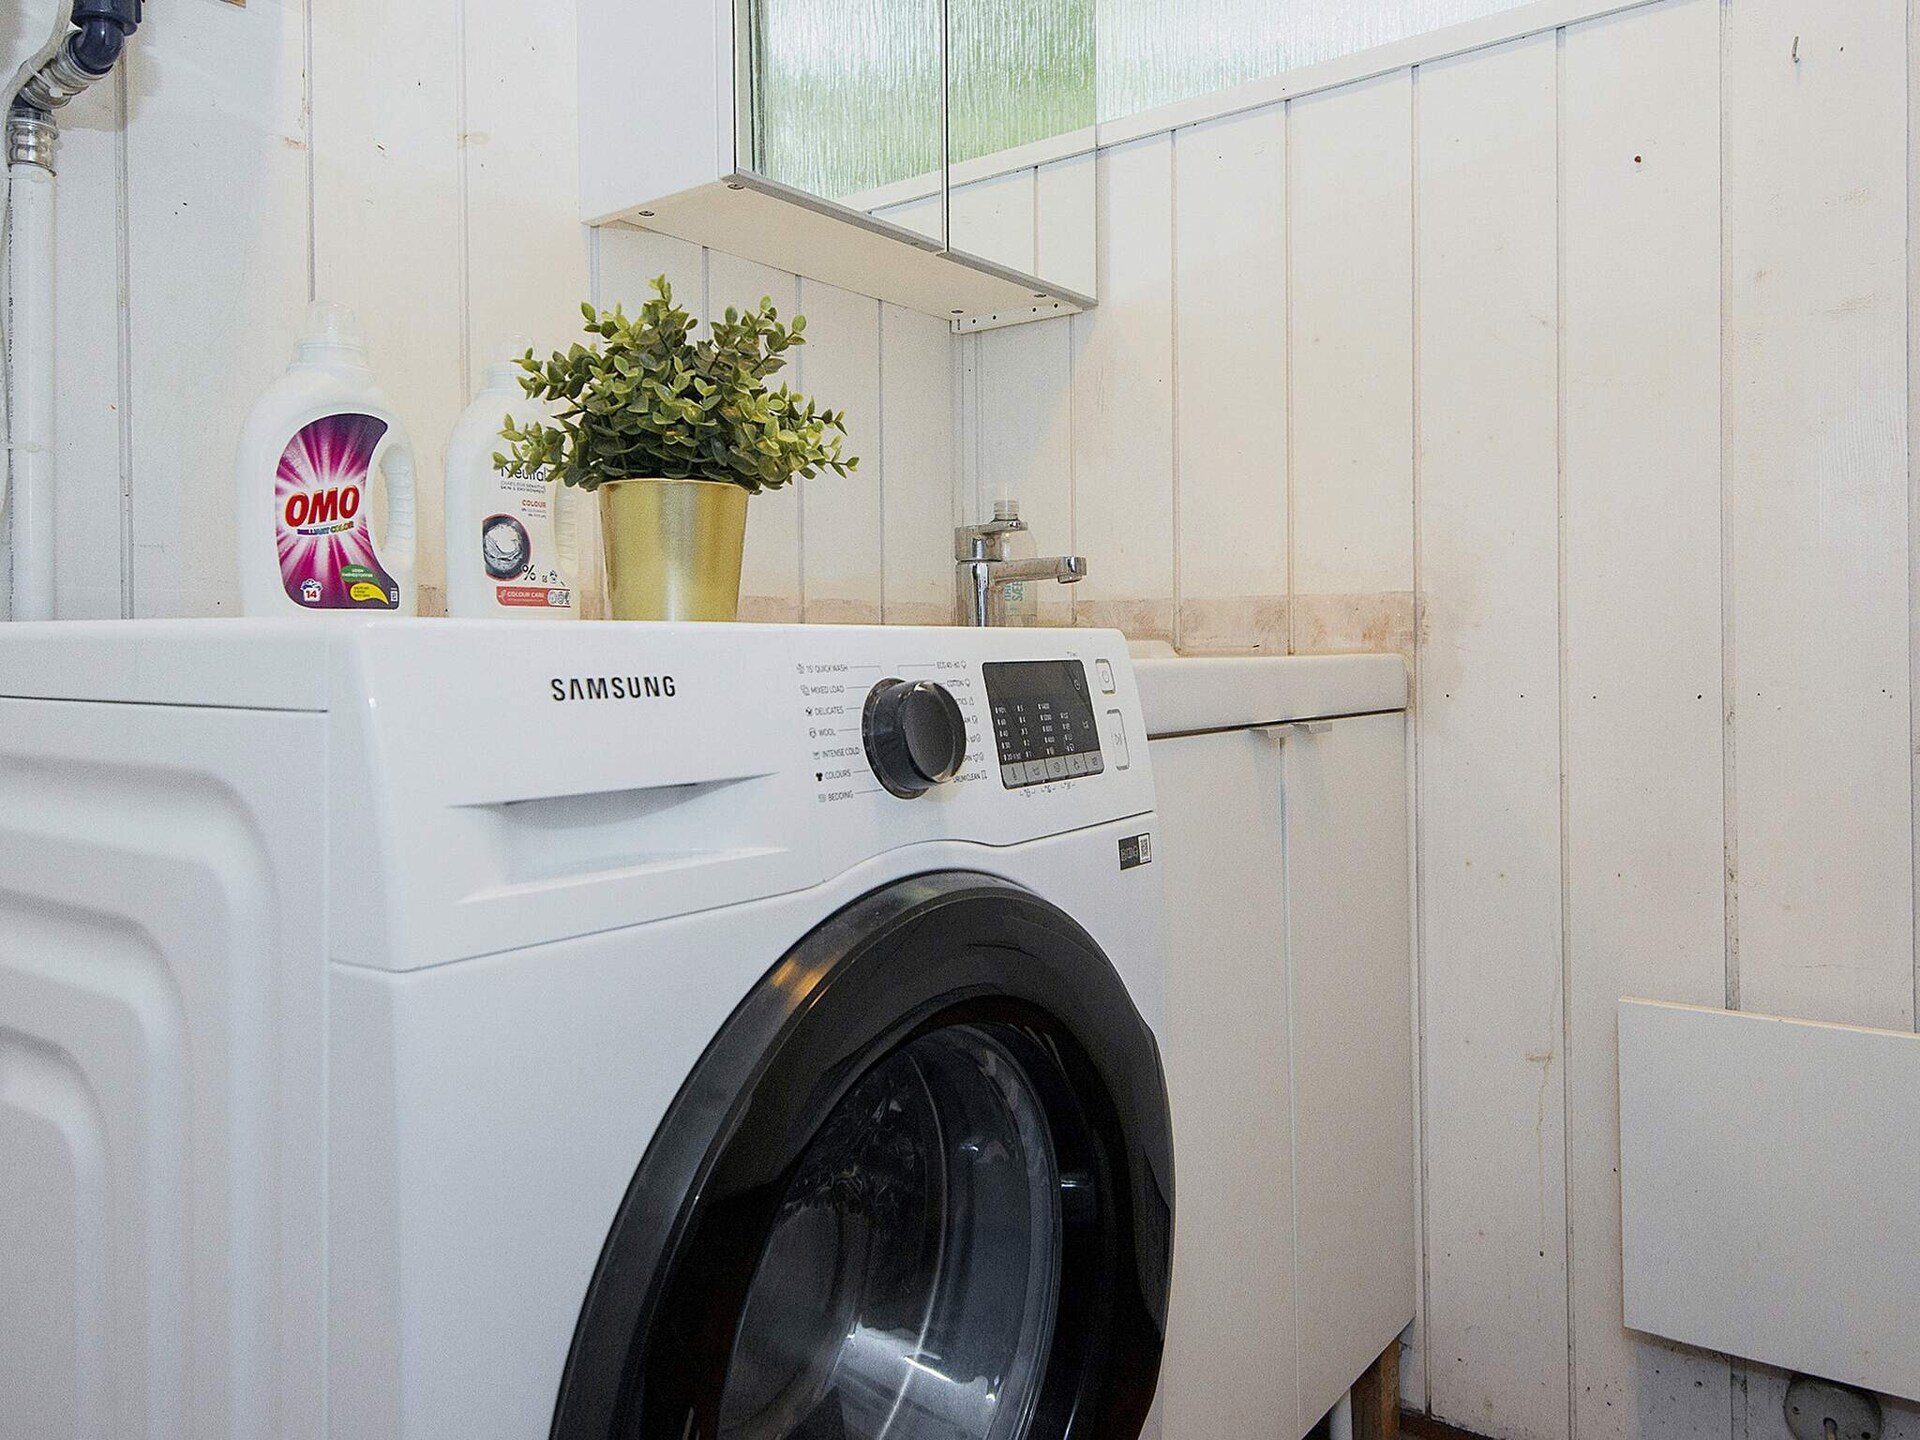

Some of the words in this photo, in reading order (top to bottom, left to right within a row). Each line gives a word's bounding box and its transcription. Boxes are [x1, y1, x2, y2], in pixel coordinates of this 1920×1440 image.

[285, 485, 360, 527] OMO
[521, 499, 546, 508] COLOUR
[305, 590, 318, 599] 14
[832, 663, 848, 672] WASH
[551, 675, 676, 702] SAMSUNG
[811, 685, 829, 695] MIXED
[830, 684, 845, 694] LOAD
[815, 705, 845, 716] DELICATES
[819, 728, 836, 737] WOOL
[822, 748, 846, 759] INTENSE
[825, 768, 852, 780] COLOURS
[828, 790, 854, 802] BEDDING
